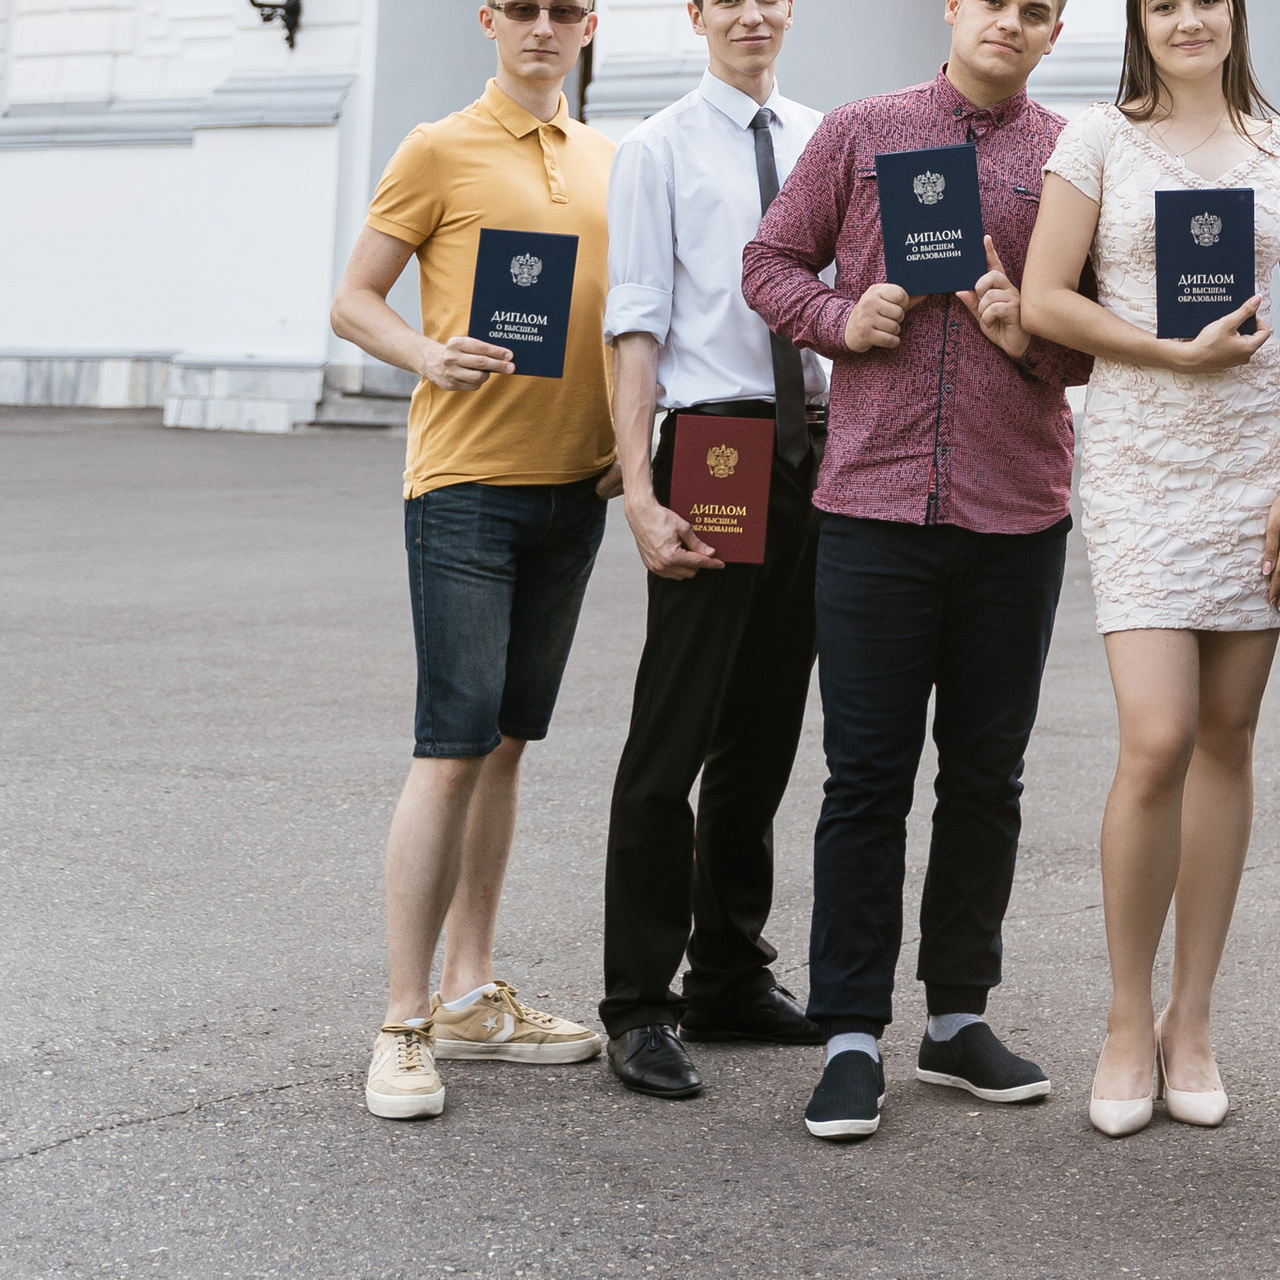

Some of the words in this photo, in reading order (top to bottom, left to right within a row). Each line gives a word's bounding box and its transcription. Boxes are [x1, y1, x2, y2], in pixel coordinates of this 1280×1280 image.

[905, 228, 962, 246] ДИПЛОМ
[912, 245, 918, 253] О
[920, 242, 955, 252] ВЫСШЕМ
[906, 250, 961, 262] ОБРАЗОВАНИИ
[1178, 273, 1235, 286] ДИПЛОМ
[1192, 286, 1226, 294] ВЫСШЕМ
[1178, 294, 1232, 302] ОБРАЗОВАНИИ
[490, 310, 548, 325] ДИПЛОМ
[496, 323, 502, 331] О
[504, 324, 538, 334] ВЫСШЕМ
[489, 331, 543, 342] ОБРАЗОВАНИИ
[690, 503, 747, 517] ДИПЛОМ
[704, 517, 738, 525] ВЫСШЕМ
